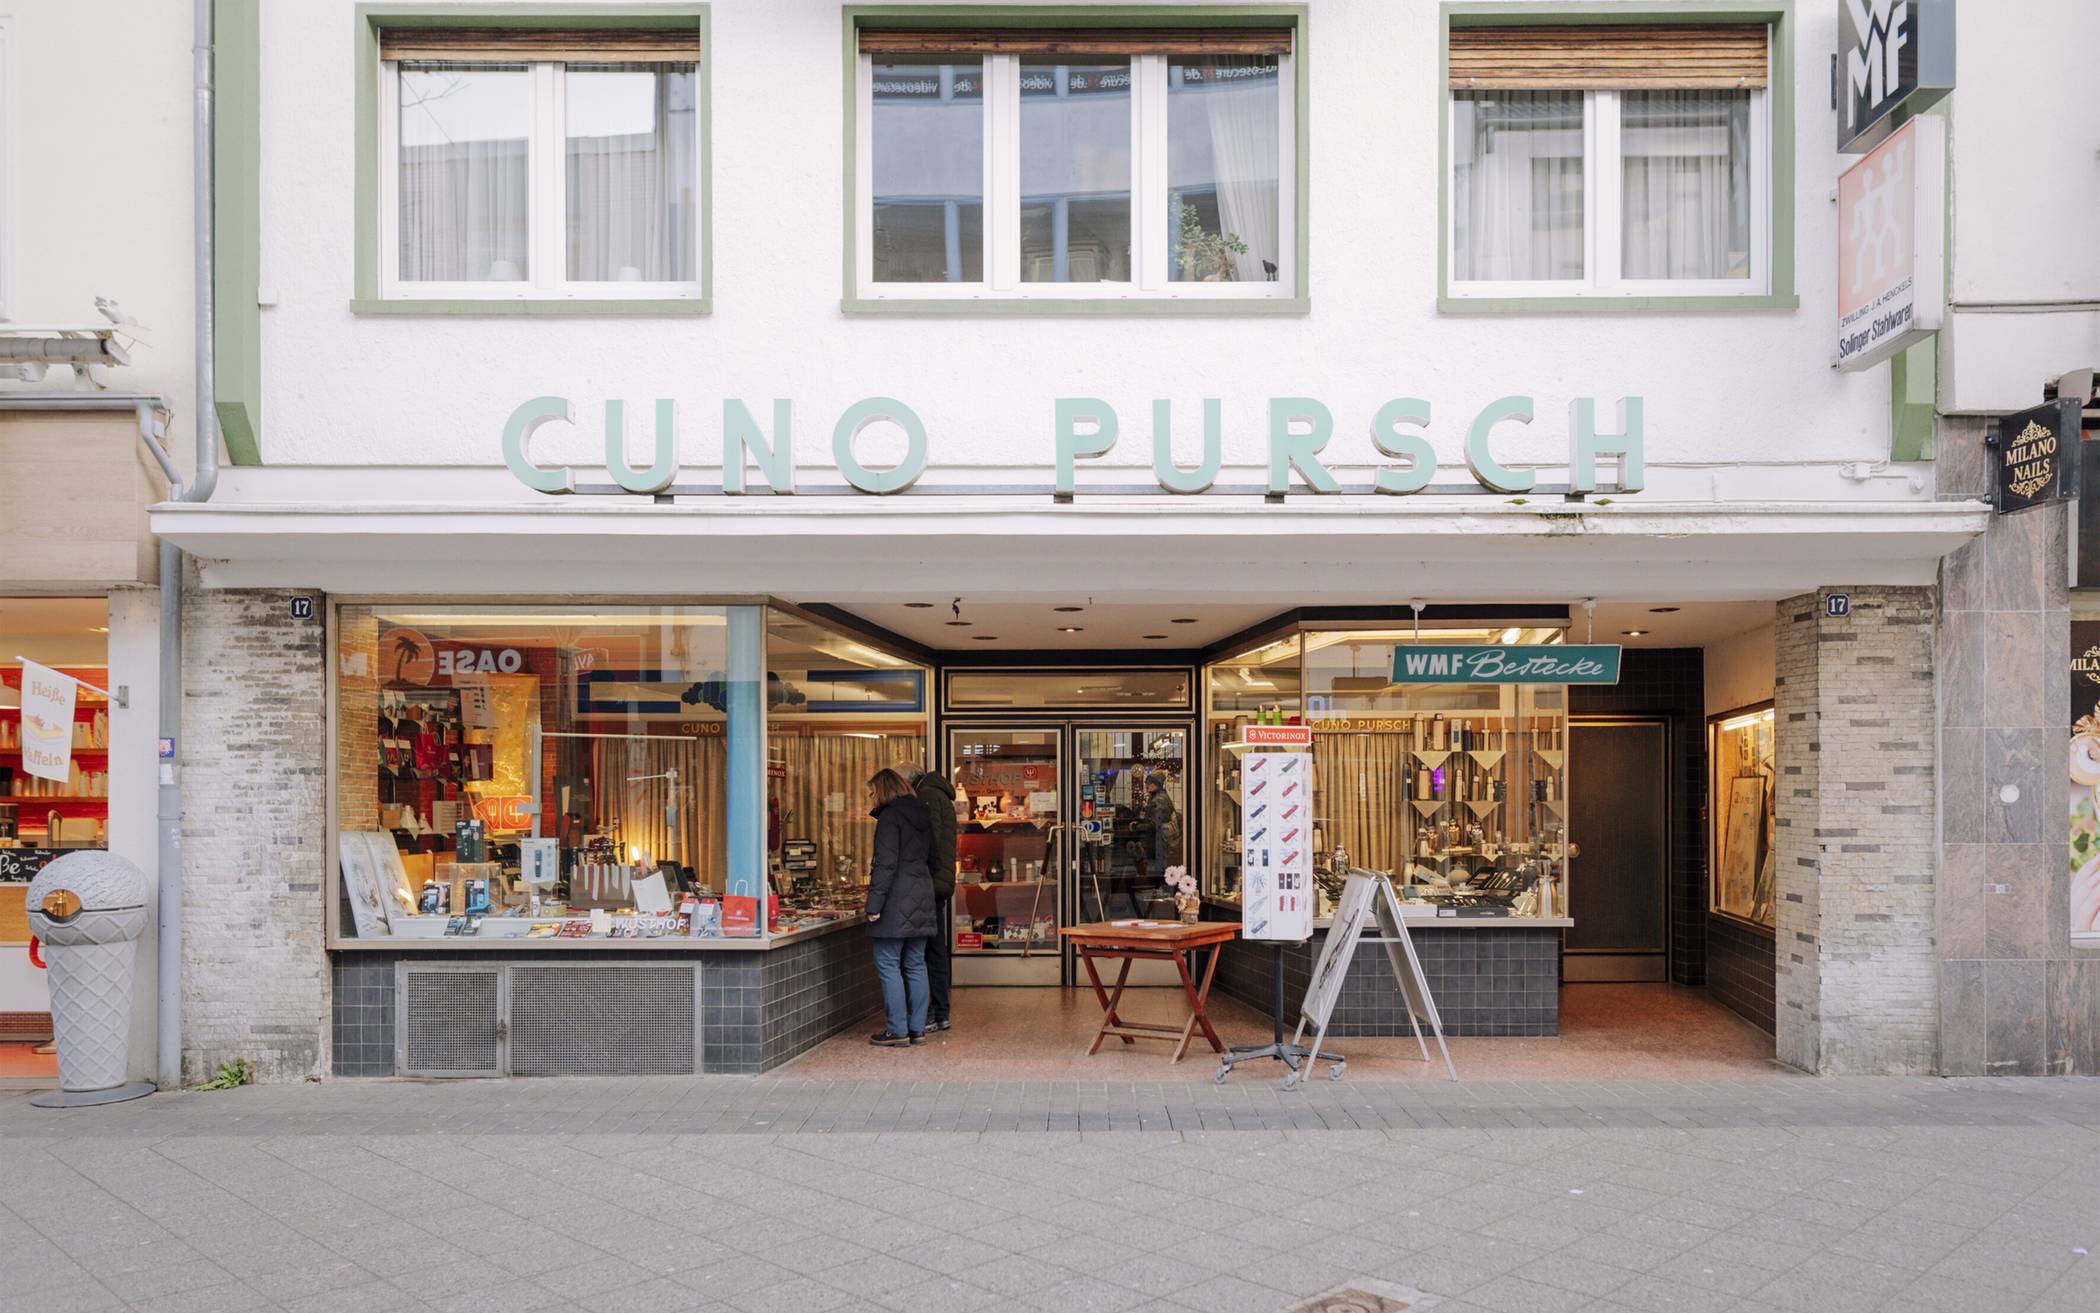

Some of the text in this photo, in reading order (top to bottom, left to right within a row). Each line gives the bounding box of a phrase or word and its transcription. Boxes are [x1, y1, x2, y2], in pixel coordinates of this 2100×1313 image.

[1846, 0, 1907, 129] WMF
[1841, 305, 1869, 328] ZWILLING
[1883, 276, 1912, 304] HENCKELS
[1840, 328, 1871, 358] Solinger
[502, 395, 1644, 495] CUNO PURSCH
[2006, 437, 2057, 467] MILANO
[2014, 458, 2050, 483] NAILS
[295, 600, 309, 615] 17
[1830, 598, 1846, 613] 17
[1406, 649, 1604, 678] WMF Bestecke
[2070, 658, 2100, 670] MILA
[32, 681, 65, 705] Heiße
[681, 723, 721, 733] CUNO
[1312, 720, 1411, 730] CUNO PURSCH
